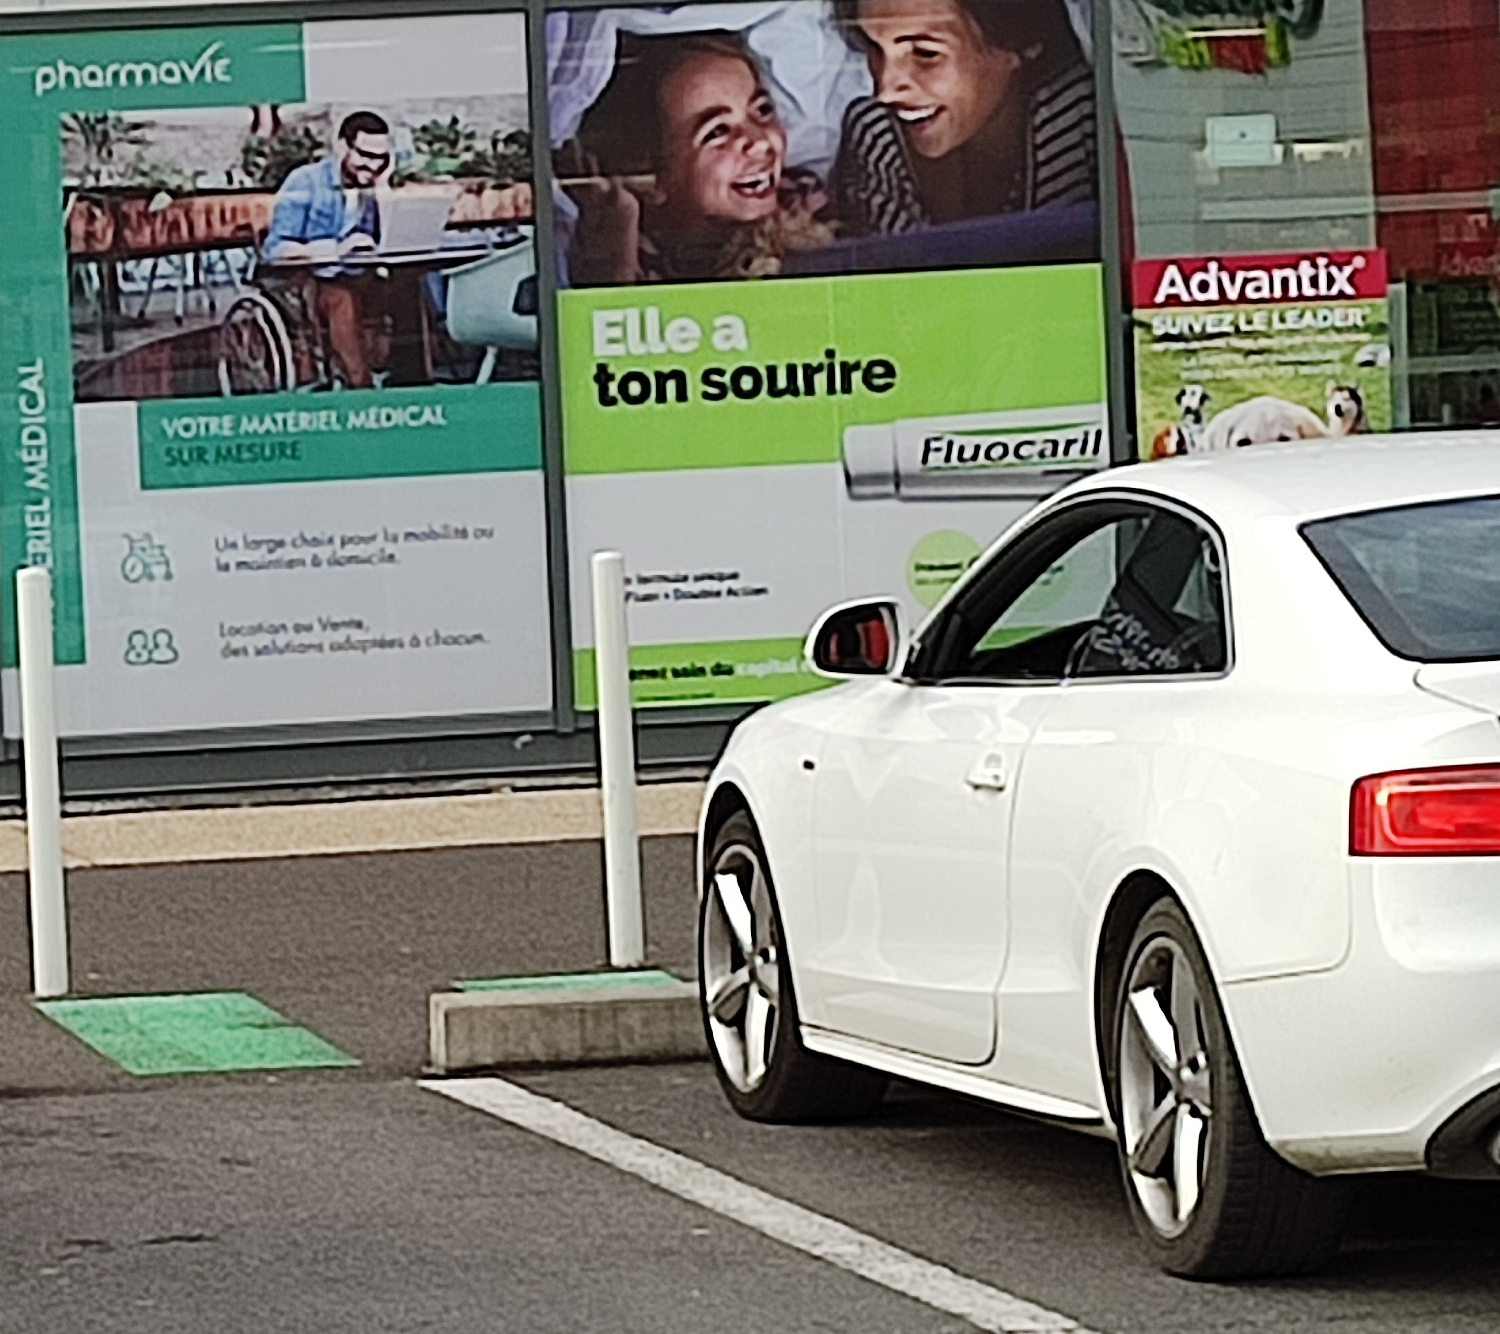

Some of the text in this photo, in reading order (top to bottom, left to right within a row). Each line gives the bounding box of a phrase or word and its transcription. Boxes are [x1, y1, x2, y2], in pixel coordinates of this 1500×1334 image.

[35, 41, 232, 97] pharmavie
[592, 306, 749, 357] Elle a
[1151, 308, 1365, 336] SUIVEZ LE LEADER
[593, 348, 897, 407] ton sourire
[16, 356, 51, 490] MÉDICAL
[161, 414, 235, 440] VOTRE
[346, 403, 449, 430] MÉDICAL
[164, 440, 302, 467] SUR MESURE
[921, 428, 1103, 466] Fluocaril
[215, 535, 239, 553] Un
[242, 534, 287, 555] large
[340, 532, 378, 550] pour
[673, 588, 722, 601] Double
[726, 585, 769, 598] Action
[219, 621, 288, 639] Location
[292, 621, 314, 634] ou
[220, 640, 249, 659] des
